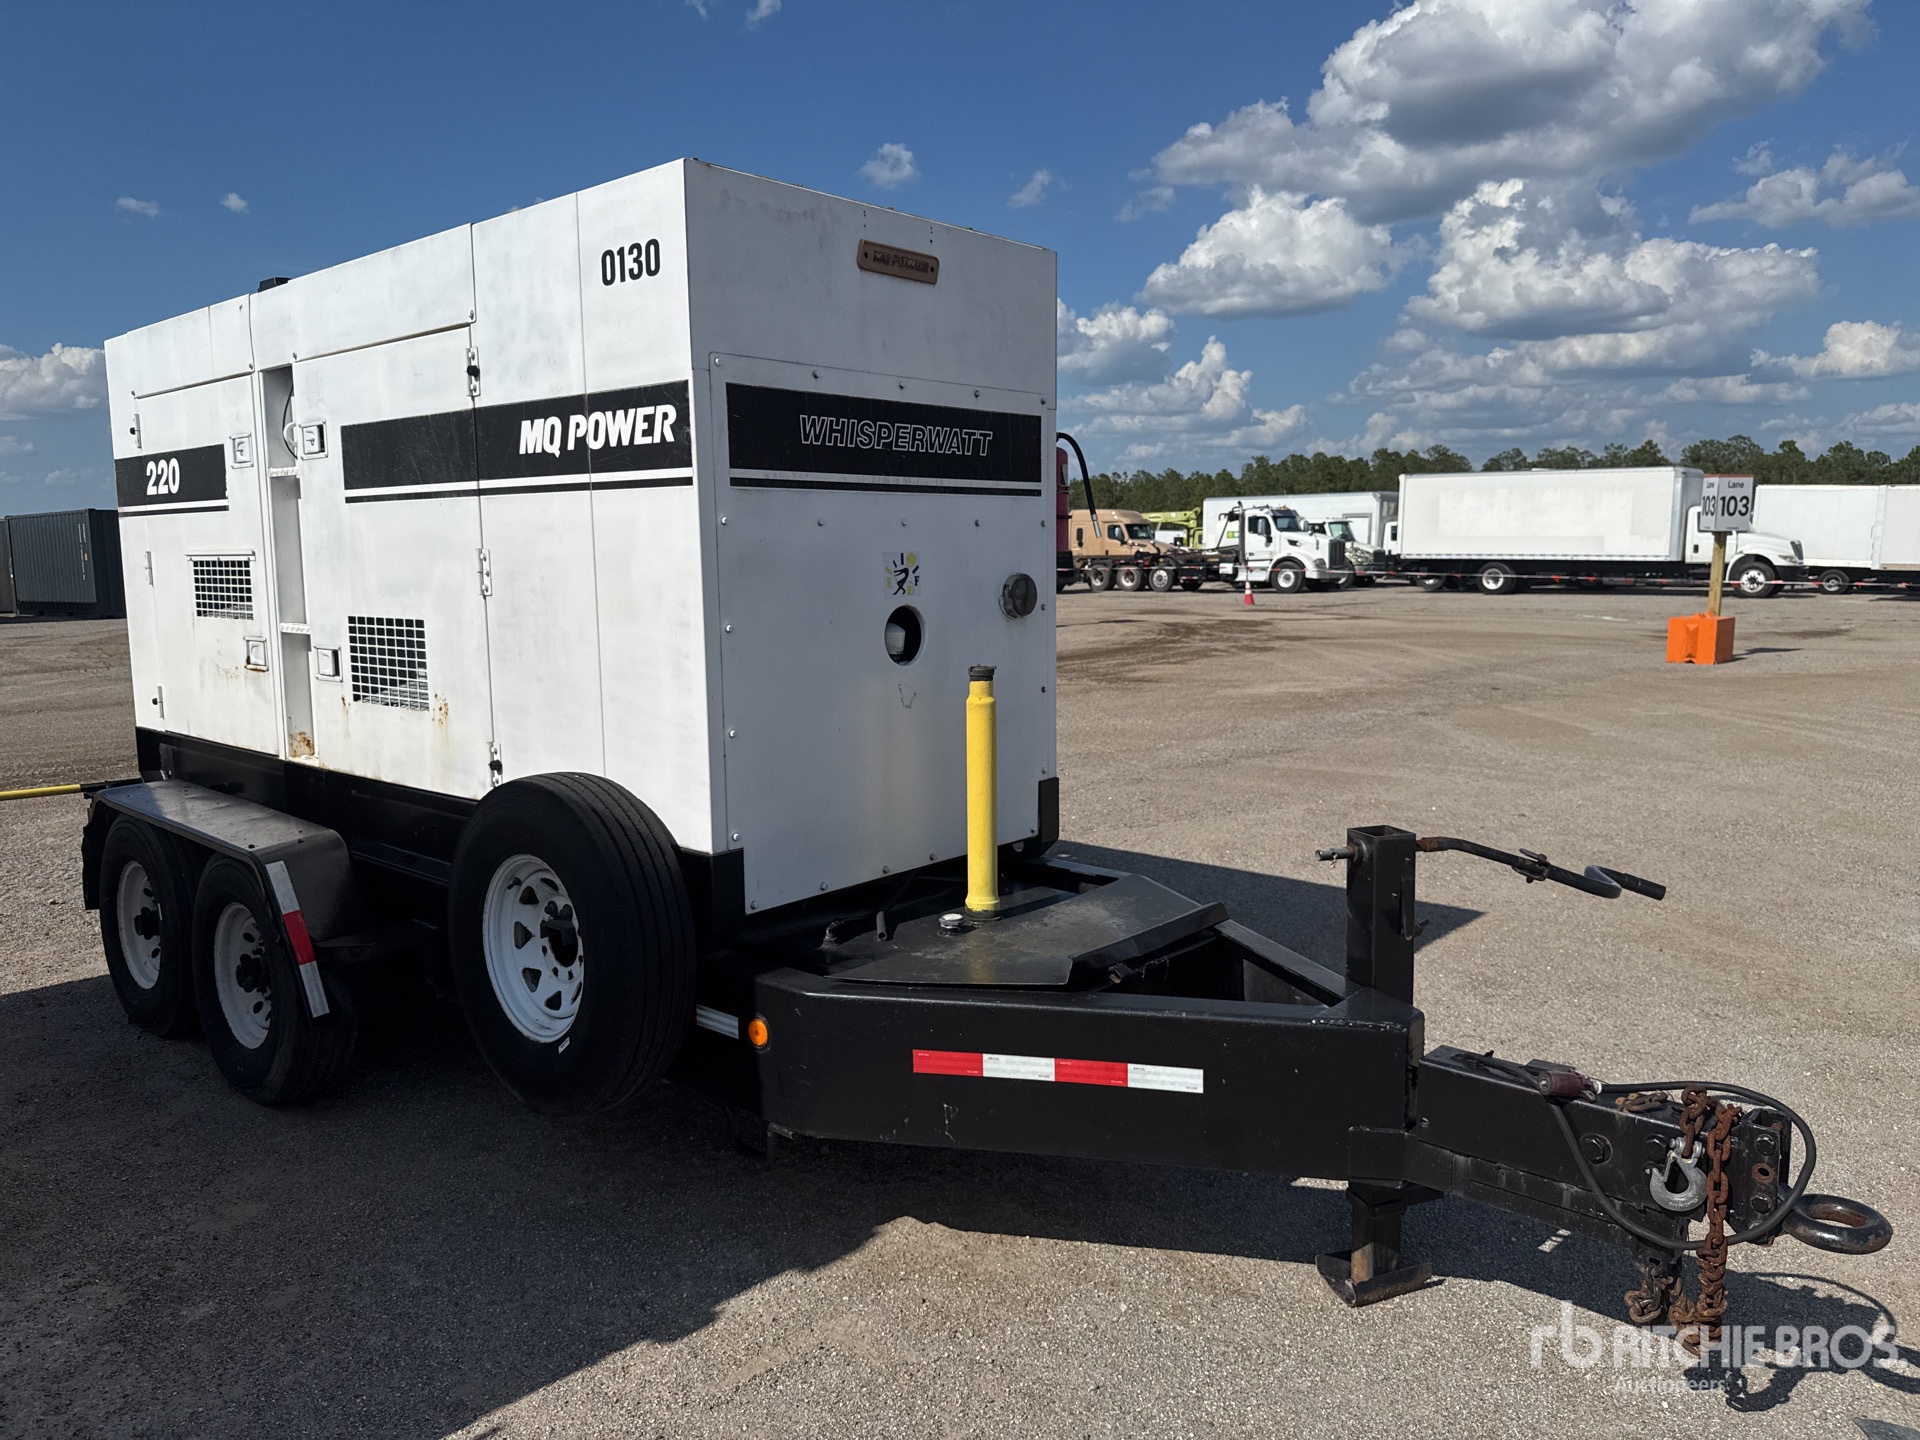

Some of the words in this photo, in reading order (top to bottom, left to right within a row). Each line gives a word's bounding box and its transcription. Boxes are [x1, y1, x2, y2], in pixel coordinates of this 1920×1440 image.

[601, 238, 660, 286] 0130
[519, 416, 562, 458] MQ
[568, 404, 677, 450] POWER
[799, 414, 993, 457] WHISPERWATT
[146, 457, 180, 496] 220
[1727, 481, 1745, 489] Lane
[1702, 495, 1716, 516] 103
[1720, 495, 1750, 517] 103
[914, 575, 920, 587] F
